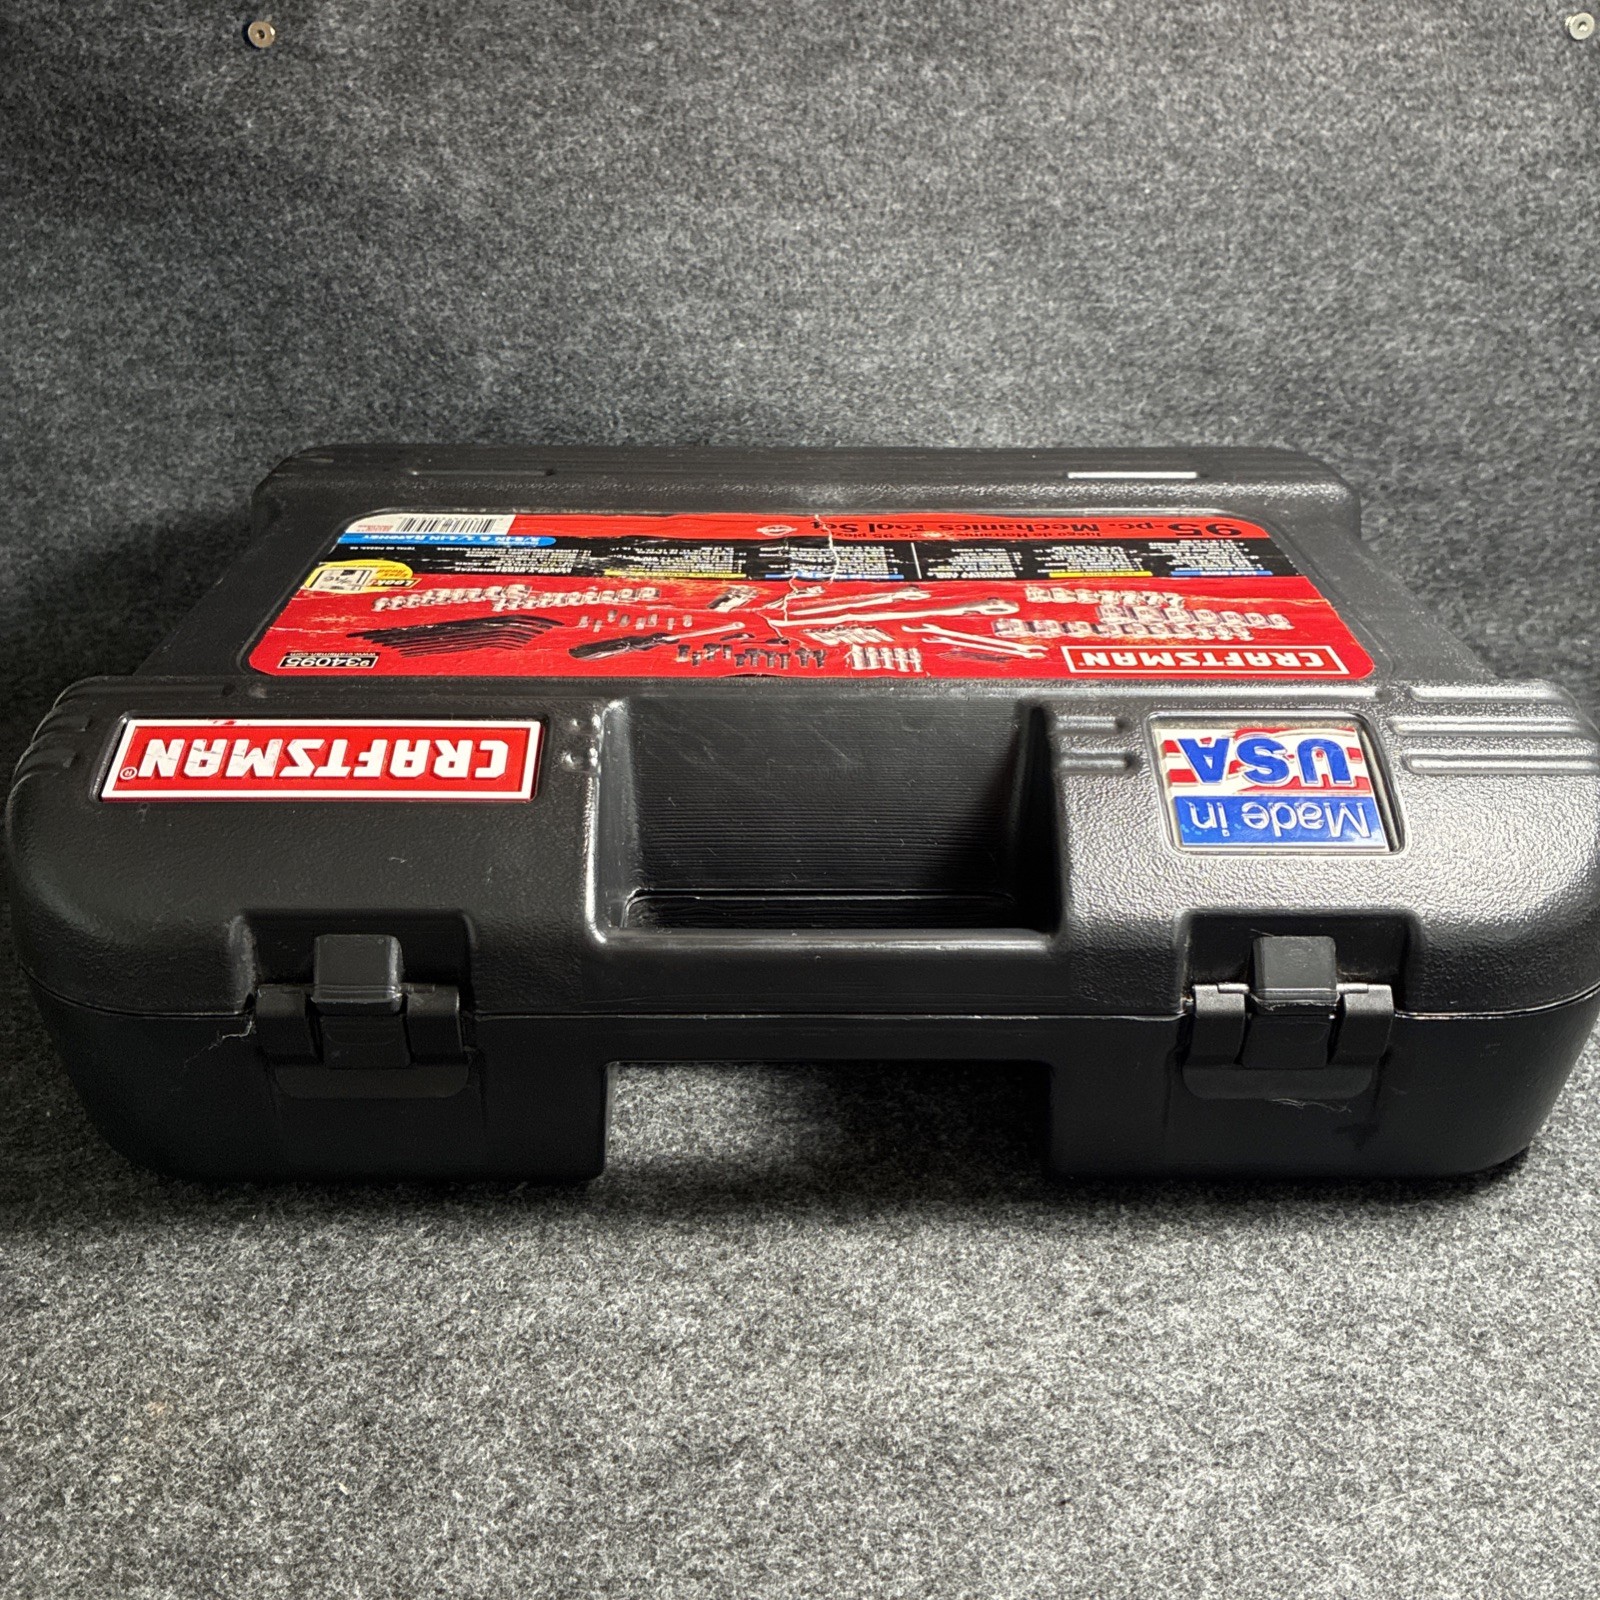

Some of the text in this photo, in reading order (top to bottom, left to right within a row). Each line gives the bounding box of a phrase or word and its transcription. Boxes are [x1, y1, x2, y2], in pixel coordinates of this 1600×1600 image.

[810, 521, 858, 533] Set
[868, 523, 926, 533] Tool
[937, 523, 1100, 533] Mechanics
[285, 657, 370, 667] 934095
[1176, 736, 1354, 786] USA
[1183, 802, 1372, 838] Made in
